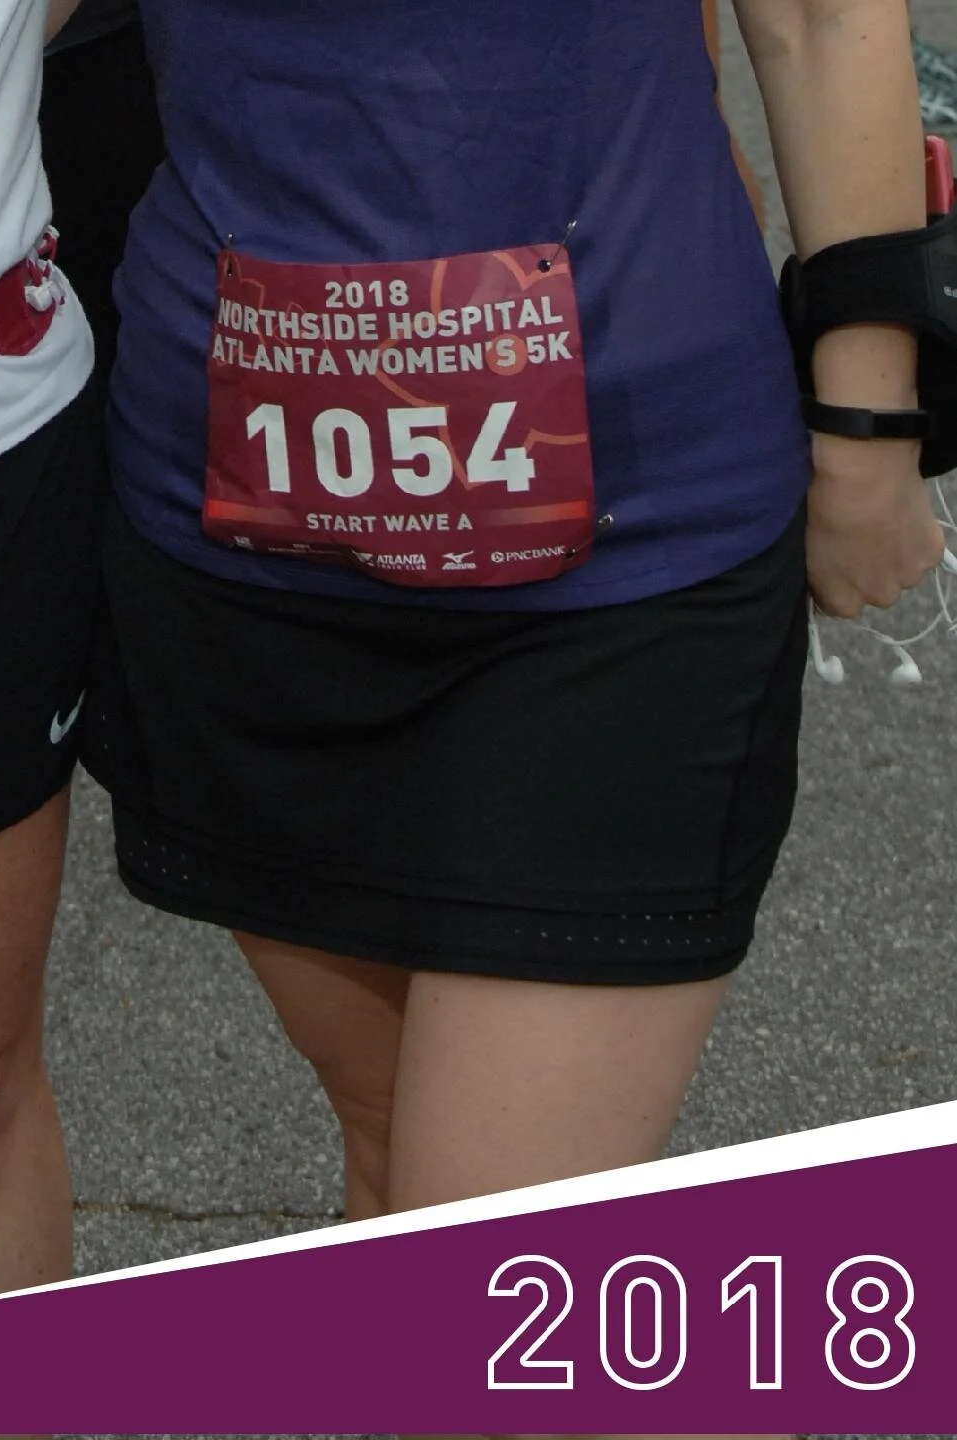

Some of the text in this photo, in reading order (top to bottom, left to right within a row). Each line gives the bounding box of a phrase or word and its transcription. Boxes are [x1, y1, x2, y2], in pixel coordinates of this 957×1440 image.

[325, 280, 409, 309] 2018
[218, 296, 563, 340] NORTHSIDE HOSPITAL
[212, 331, 573, 376] ATLANTA WOMEN'S 5K
[246, 401, 535, 497] 1054
[306, 512, 473, 533] START WAVE A
[377, 553, 427, 565] ATLANTA
